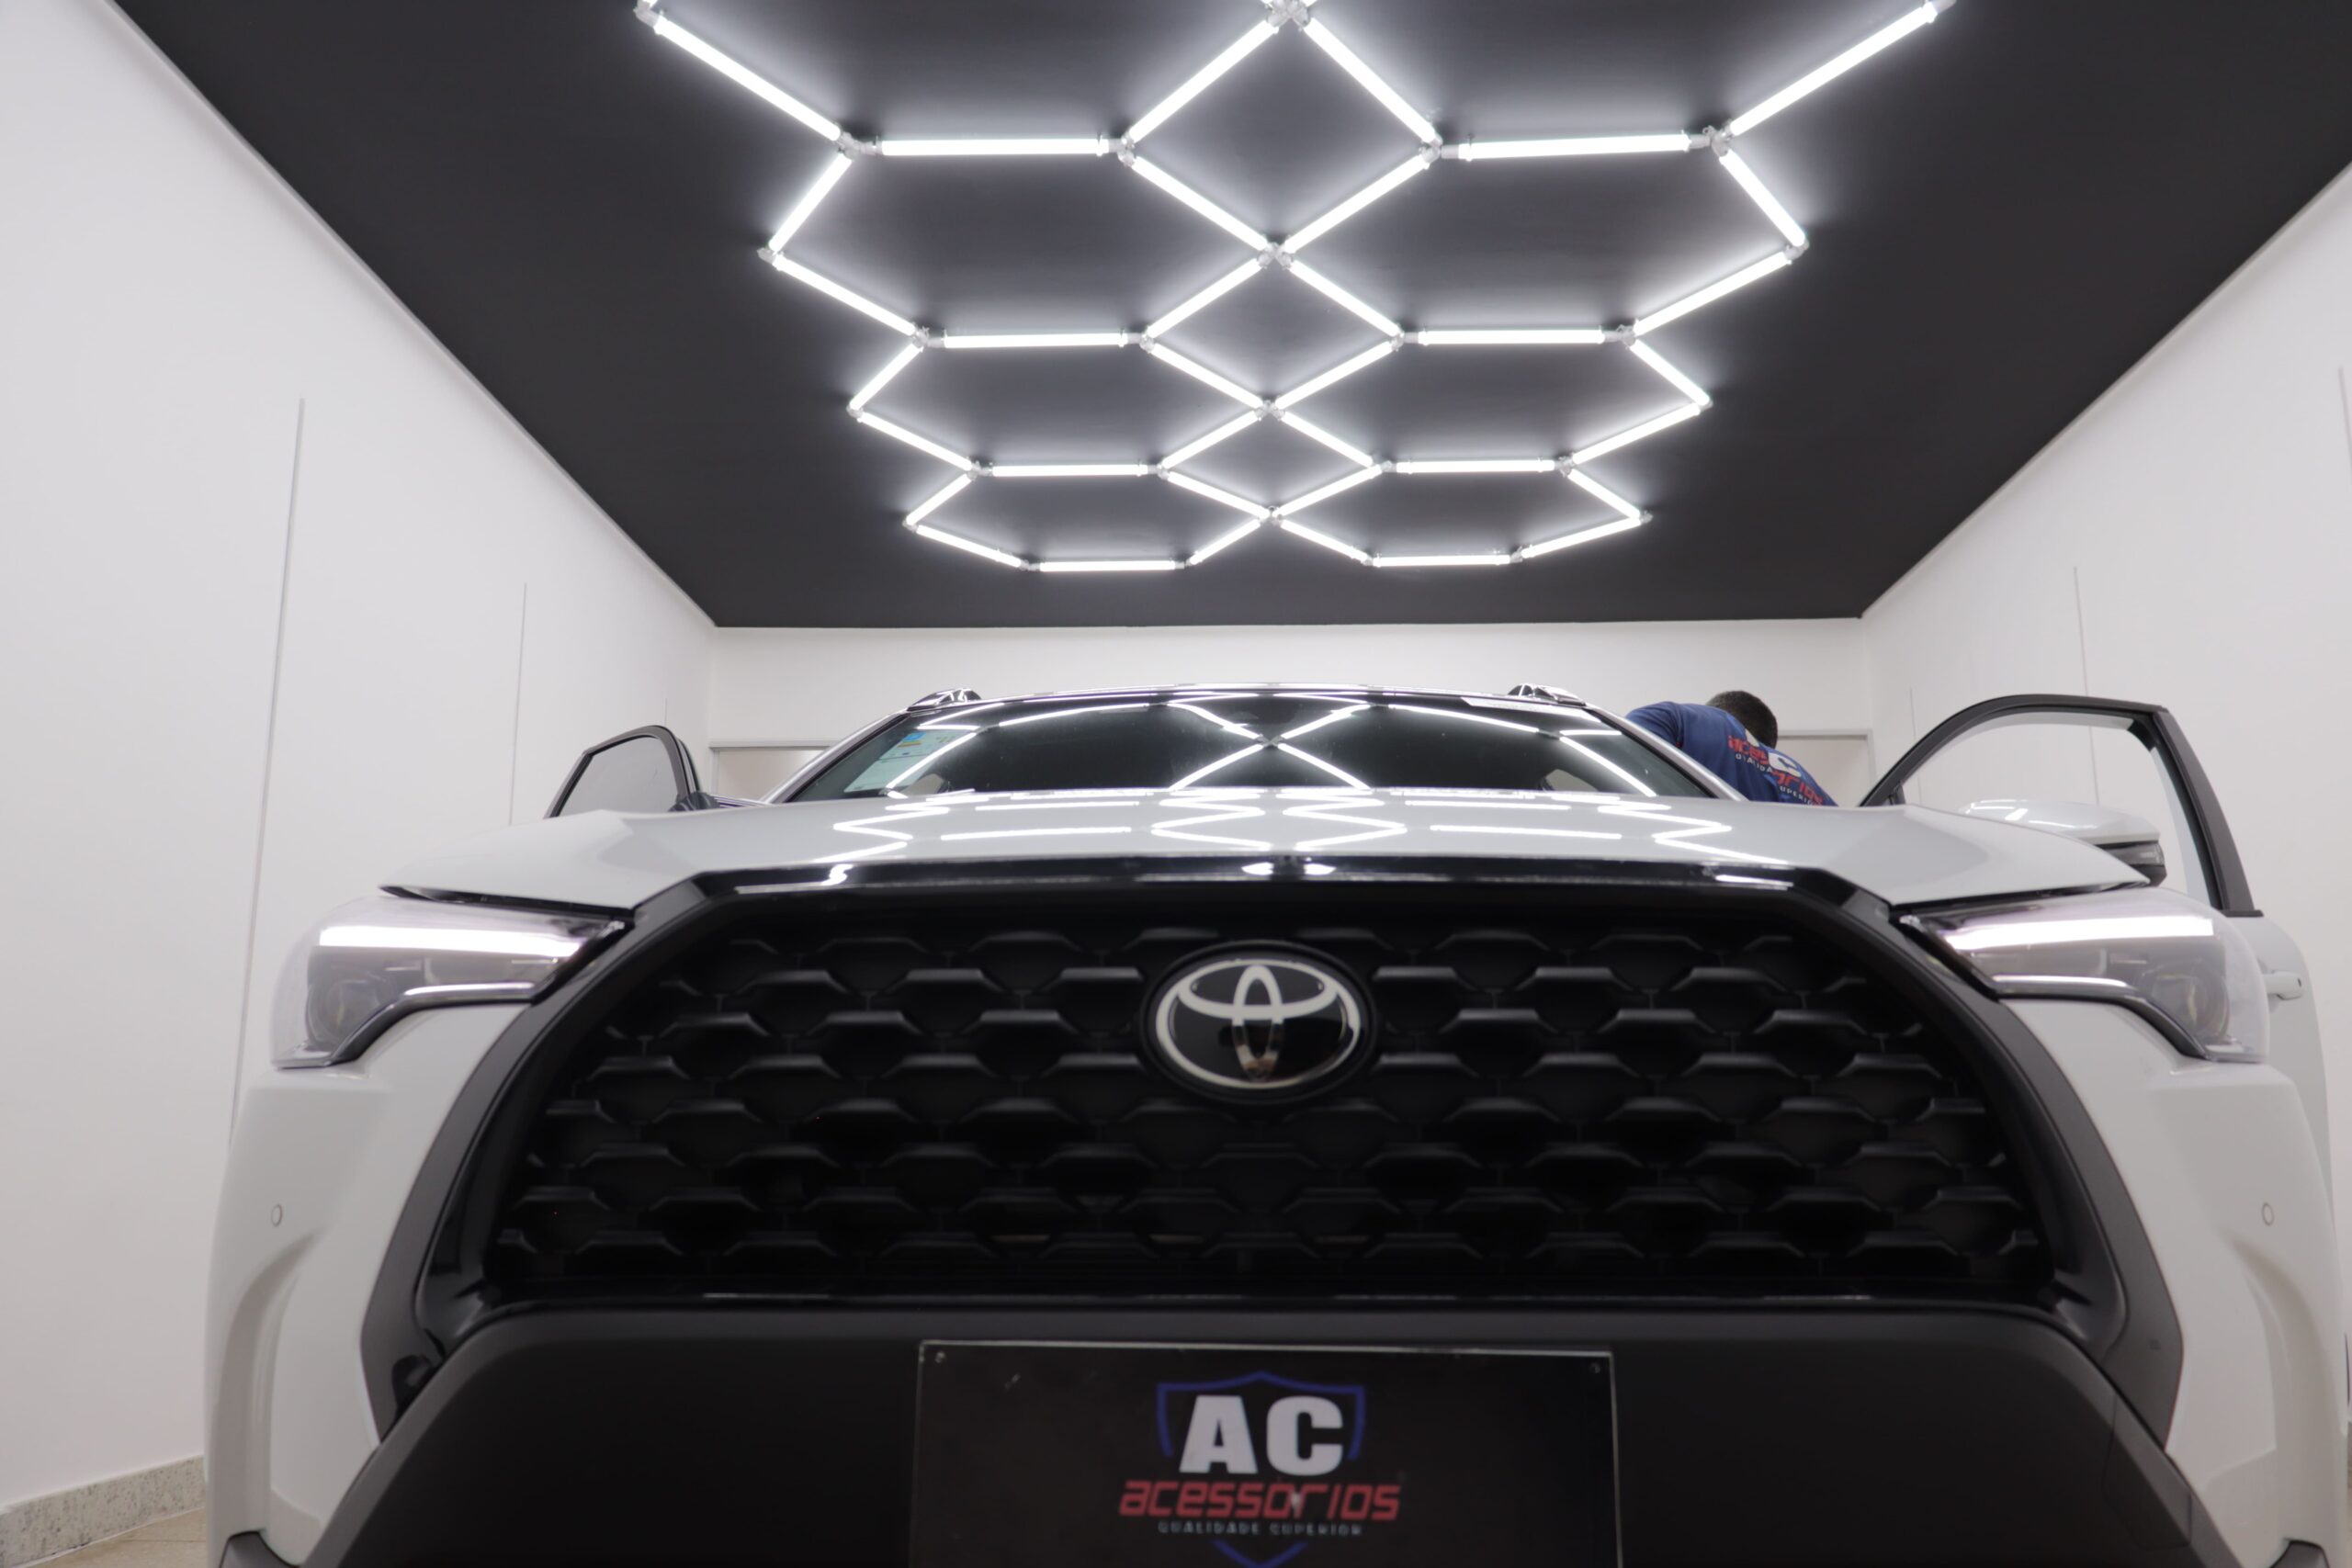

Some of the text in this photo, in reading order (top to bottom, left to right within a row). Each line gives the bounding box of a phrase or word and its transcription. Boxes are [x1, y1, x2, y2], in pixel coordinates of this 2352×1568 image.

[1179, 1394, 1343, 1476] AC
[1119, 1481, 1401, 1521] acessorios
[1158, 1521, 1363, 1537] QUALIDADE SUPERIOR
